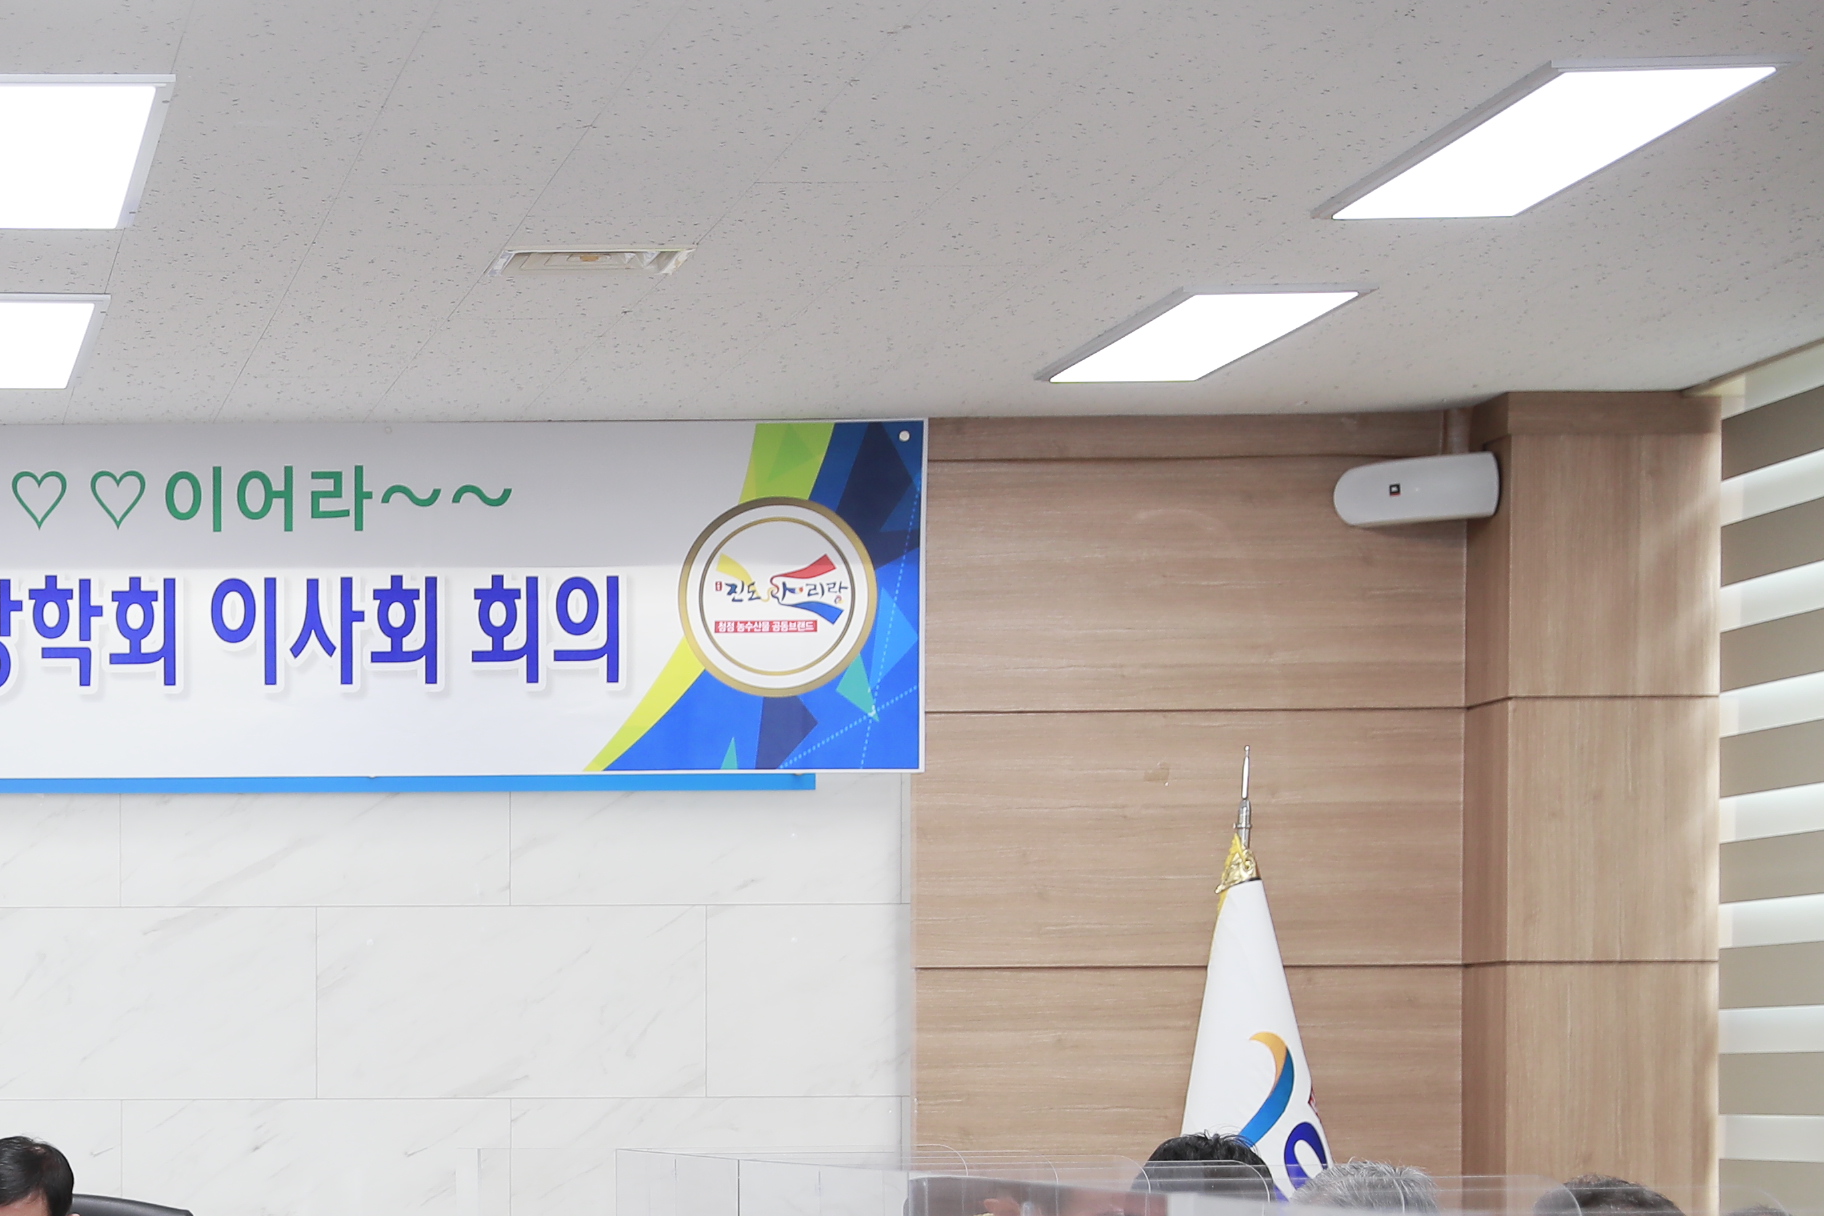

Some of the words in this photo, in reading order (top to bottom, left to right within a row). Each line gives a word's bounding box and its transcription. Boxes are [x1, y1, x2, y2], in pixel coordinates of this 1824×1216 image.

[210, 574, 438, 686] 이사회
[471, 574, 621, 685] 회의
[717, 620, 735, 633] 청정
[736, 620, 770, 633] 농수산물
[771, 619, 815, 633] 공동브랜드
